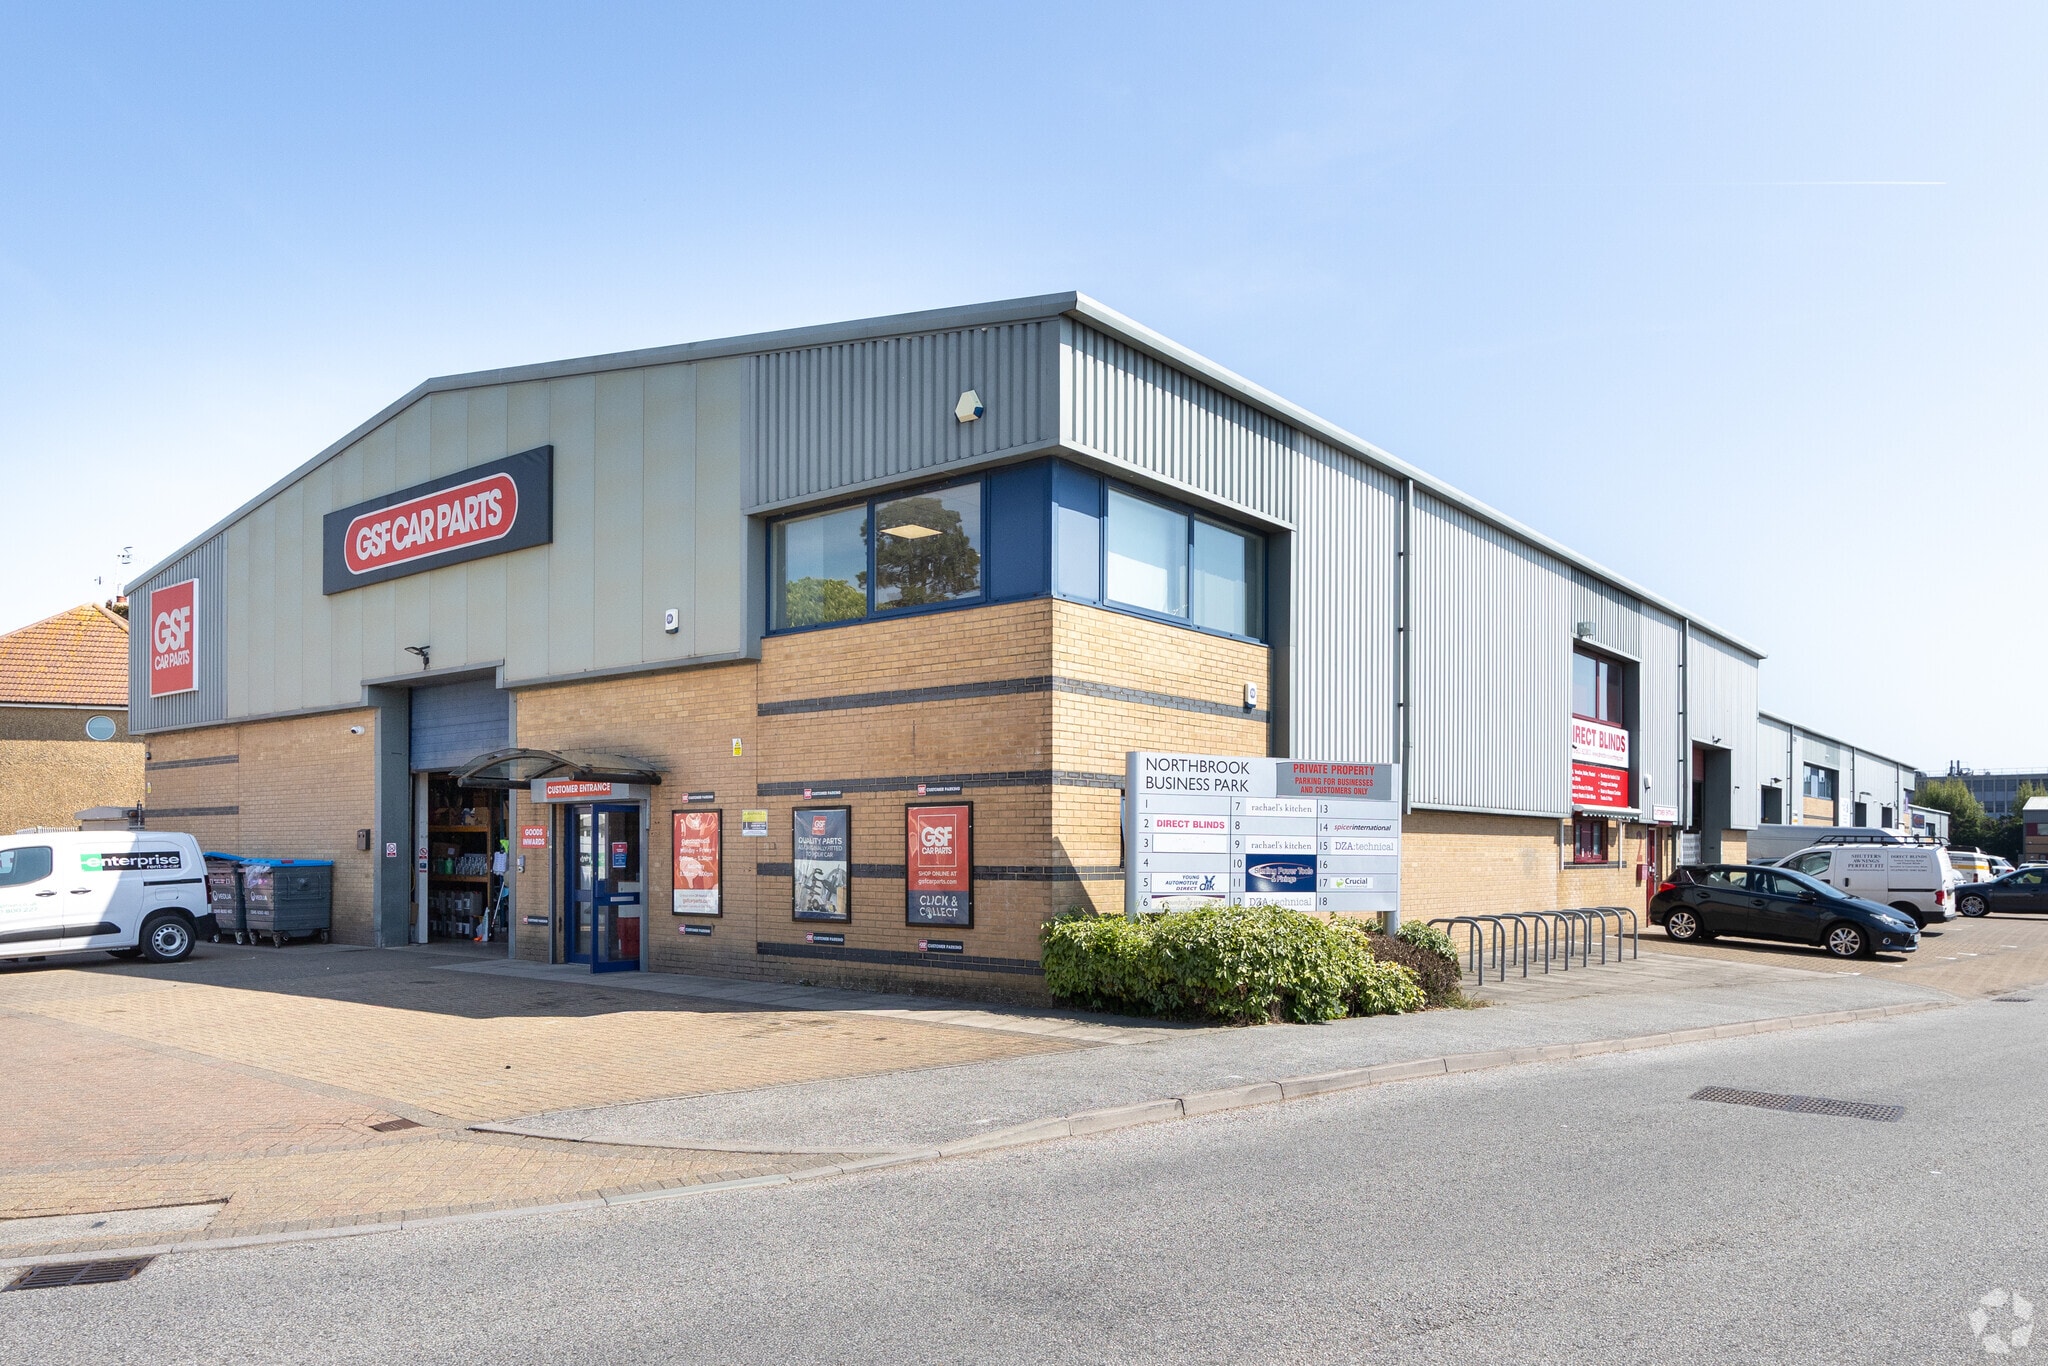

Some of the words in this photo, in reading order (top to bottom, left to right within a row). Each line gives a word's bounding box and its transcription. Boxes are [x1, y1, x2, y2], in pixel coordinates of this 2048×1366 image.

[356, 521, 391, 561] GSF
[391, 508, 434, 551] CAR
[437, 488, 502, 540] PARTS
[154, 606, 190, 653] GSF
[155, 653, 169, 671] CAR
[169, 649, 190, 668] PARTS
[1572, 725, 1596, 746] IRECT
[1599, 731, 1626, 753] BLINDS
[1146, 757, 1250, 775] NORTHBROOK
[1293, 763, 1328, 774] PRIVATE
[1331, 764, 1375, 776] PROPERTY
[1146, 776, 1210, 791] BUSINESS
[1214, 778, 1249, 793] PARK
[1295, 777, 1322, 785] PARKING
[1323, 777, 1336, 786] FOR
[1337, 778, 1374, 787] BUSINESSES
[547, 784, 579, 794] CUSTOMER
[579, 782, 611, 793] ENTRANCE
[1300, 786, 1313, 794] AND
[1315, 786, 1352, 795] CUSTOMERS
[1353, 787, 1368, 796] ONLY
[1235, 802, 1241, 811] 7
[1251, 804, 1283, 812] rachael's
[1284, 804, 1312, 813] kitchen
[1320, 804, 1328, 814] 13
[1144, 819, 1149, 828] 2
[1156, 819, 1190, 828] DIRECT
[1192, 820, 1225, 829] BLINDS
[1235, 821, 1241, 830] 8
[1320, 823, 1328, 832] 14
[1333, 824, 1392, 832] spicerinternational
[525, 828, 543, 836] GOODS
[921, 826, 953, 847] GSF
[522, 838, 545, 846] INWARDS
[798, 837, 822, 845] QUALITY
[822, 837, 843, 845] PARTS
[1143, 838, 1149, 848] 3
[1235, 840, 1240, 849] 9
[1251, 841, 1283, 849] rachael's
[1284, 841, 1312, 850] kitchen
[921, 846, 934, 855] CAR
[934, 846, 953, 855] PARTS
[1319, 842, 1328, 850] 15
[86, 854, 180, 869] enterprise
[1143, 858, 1149, 867] 4
[1233, 859, 1242, 868] 10
[1319, 860, 1328, 869] 16
[1143, 878, 1149, 887] 5
[1233, 878, 1241, 887] 11
[1319, 878, 1328, 887] 17
[1344, 877, 1368, 885] Crucial
[919, 895, 949, 906] CLICK
[951, 896, 958, 907] &
[1143, 897, 1148, 906] 6
[1233, 897, 1242, 906] 12
[1319, 897, 1328, 906] 18
[919, 906, 958, 918] COLLECT
